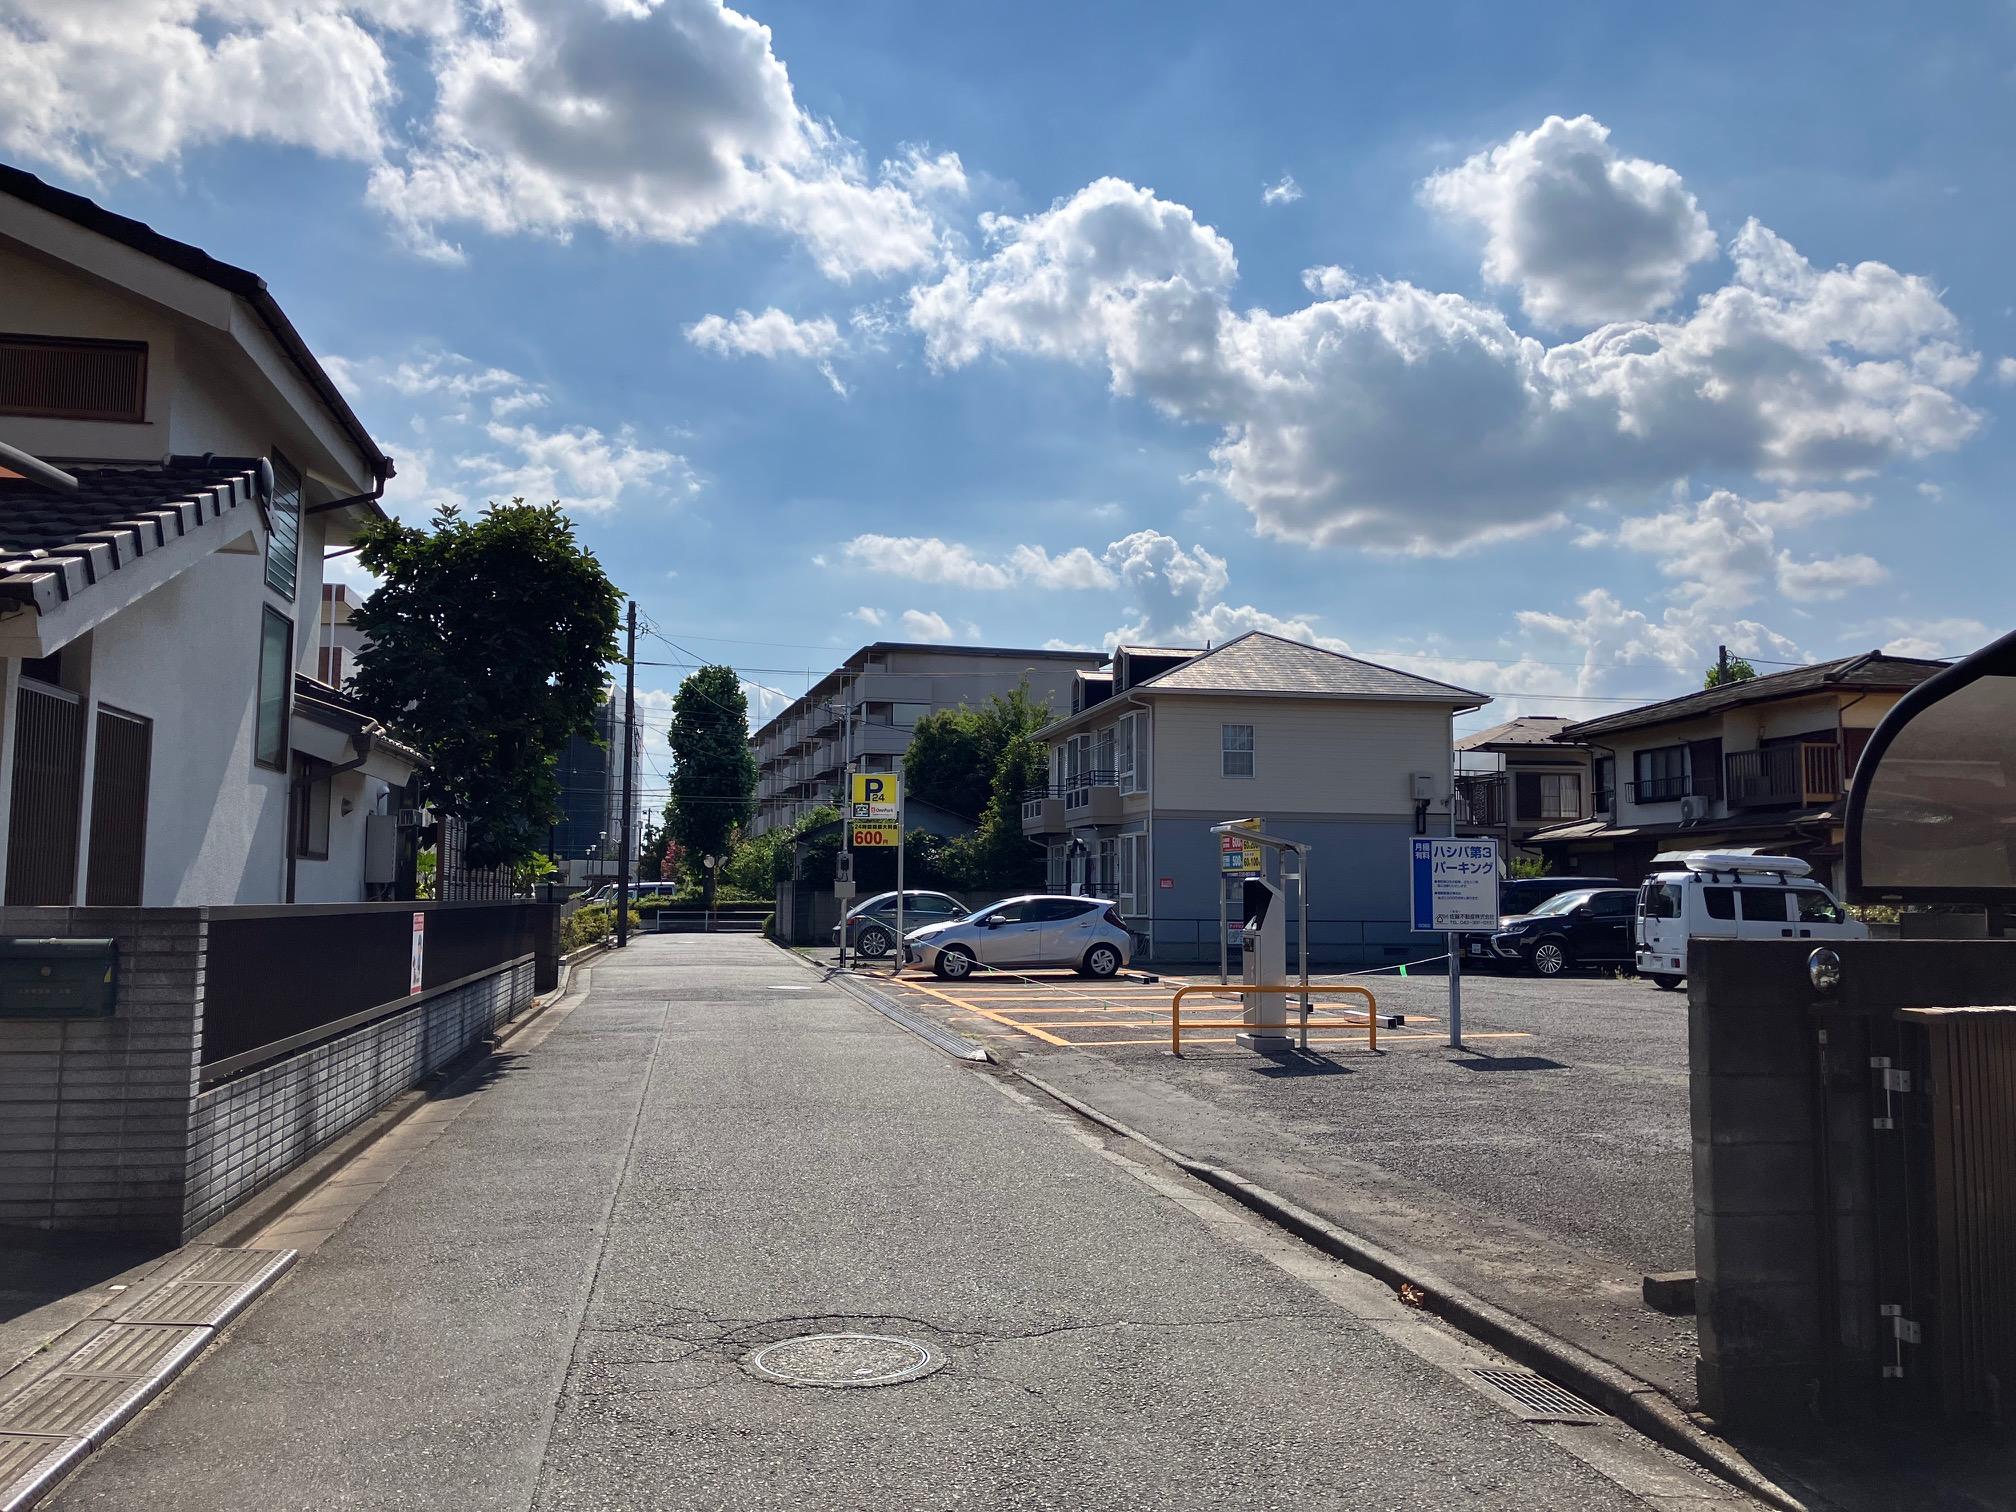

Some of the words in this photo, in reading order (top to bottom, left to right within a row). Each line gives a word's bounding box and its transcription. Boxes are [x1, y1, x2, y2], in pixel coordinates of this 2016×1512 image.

[865, 779, 883, 801] P
[1434, 846, 1492, 859] ハシバ第3
[1434, 861, 1493, 874] パーキング
